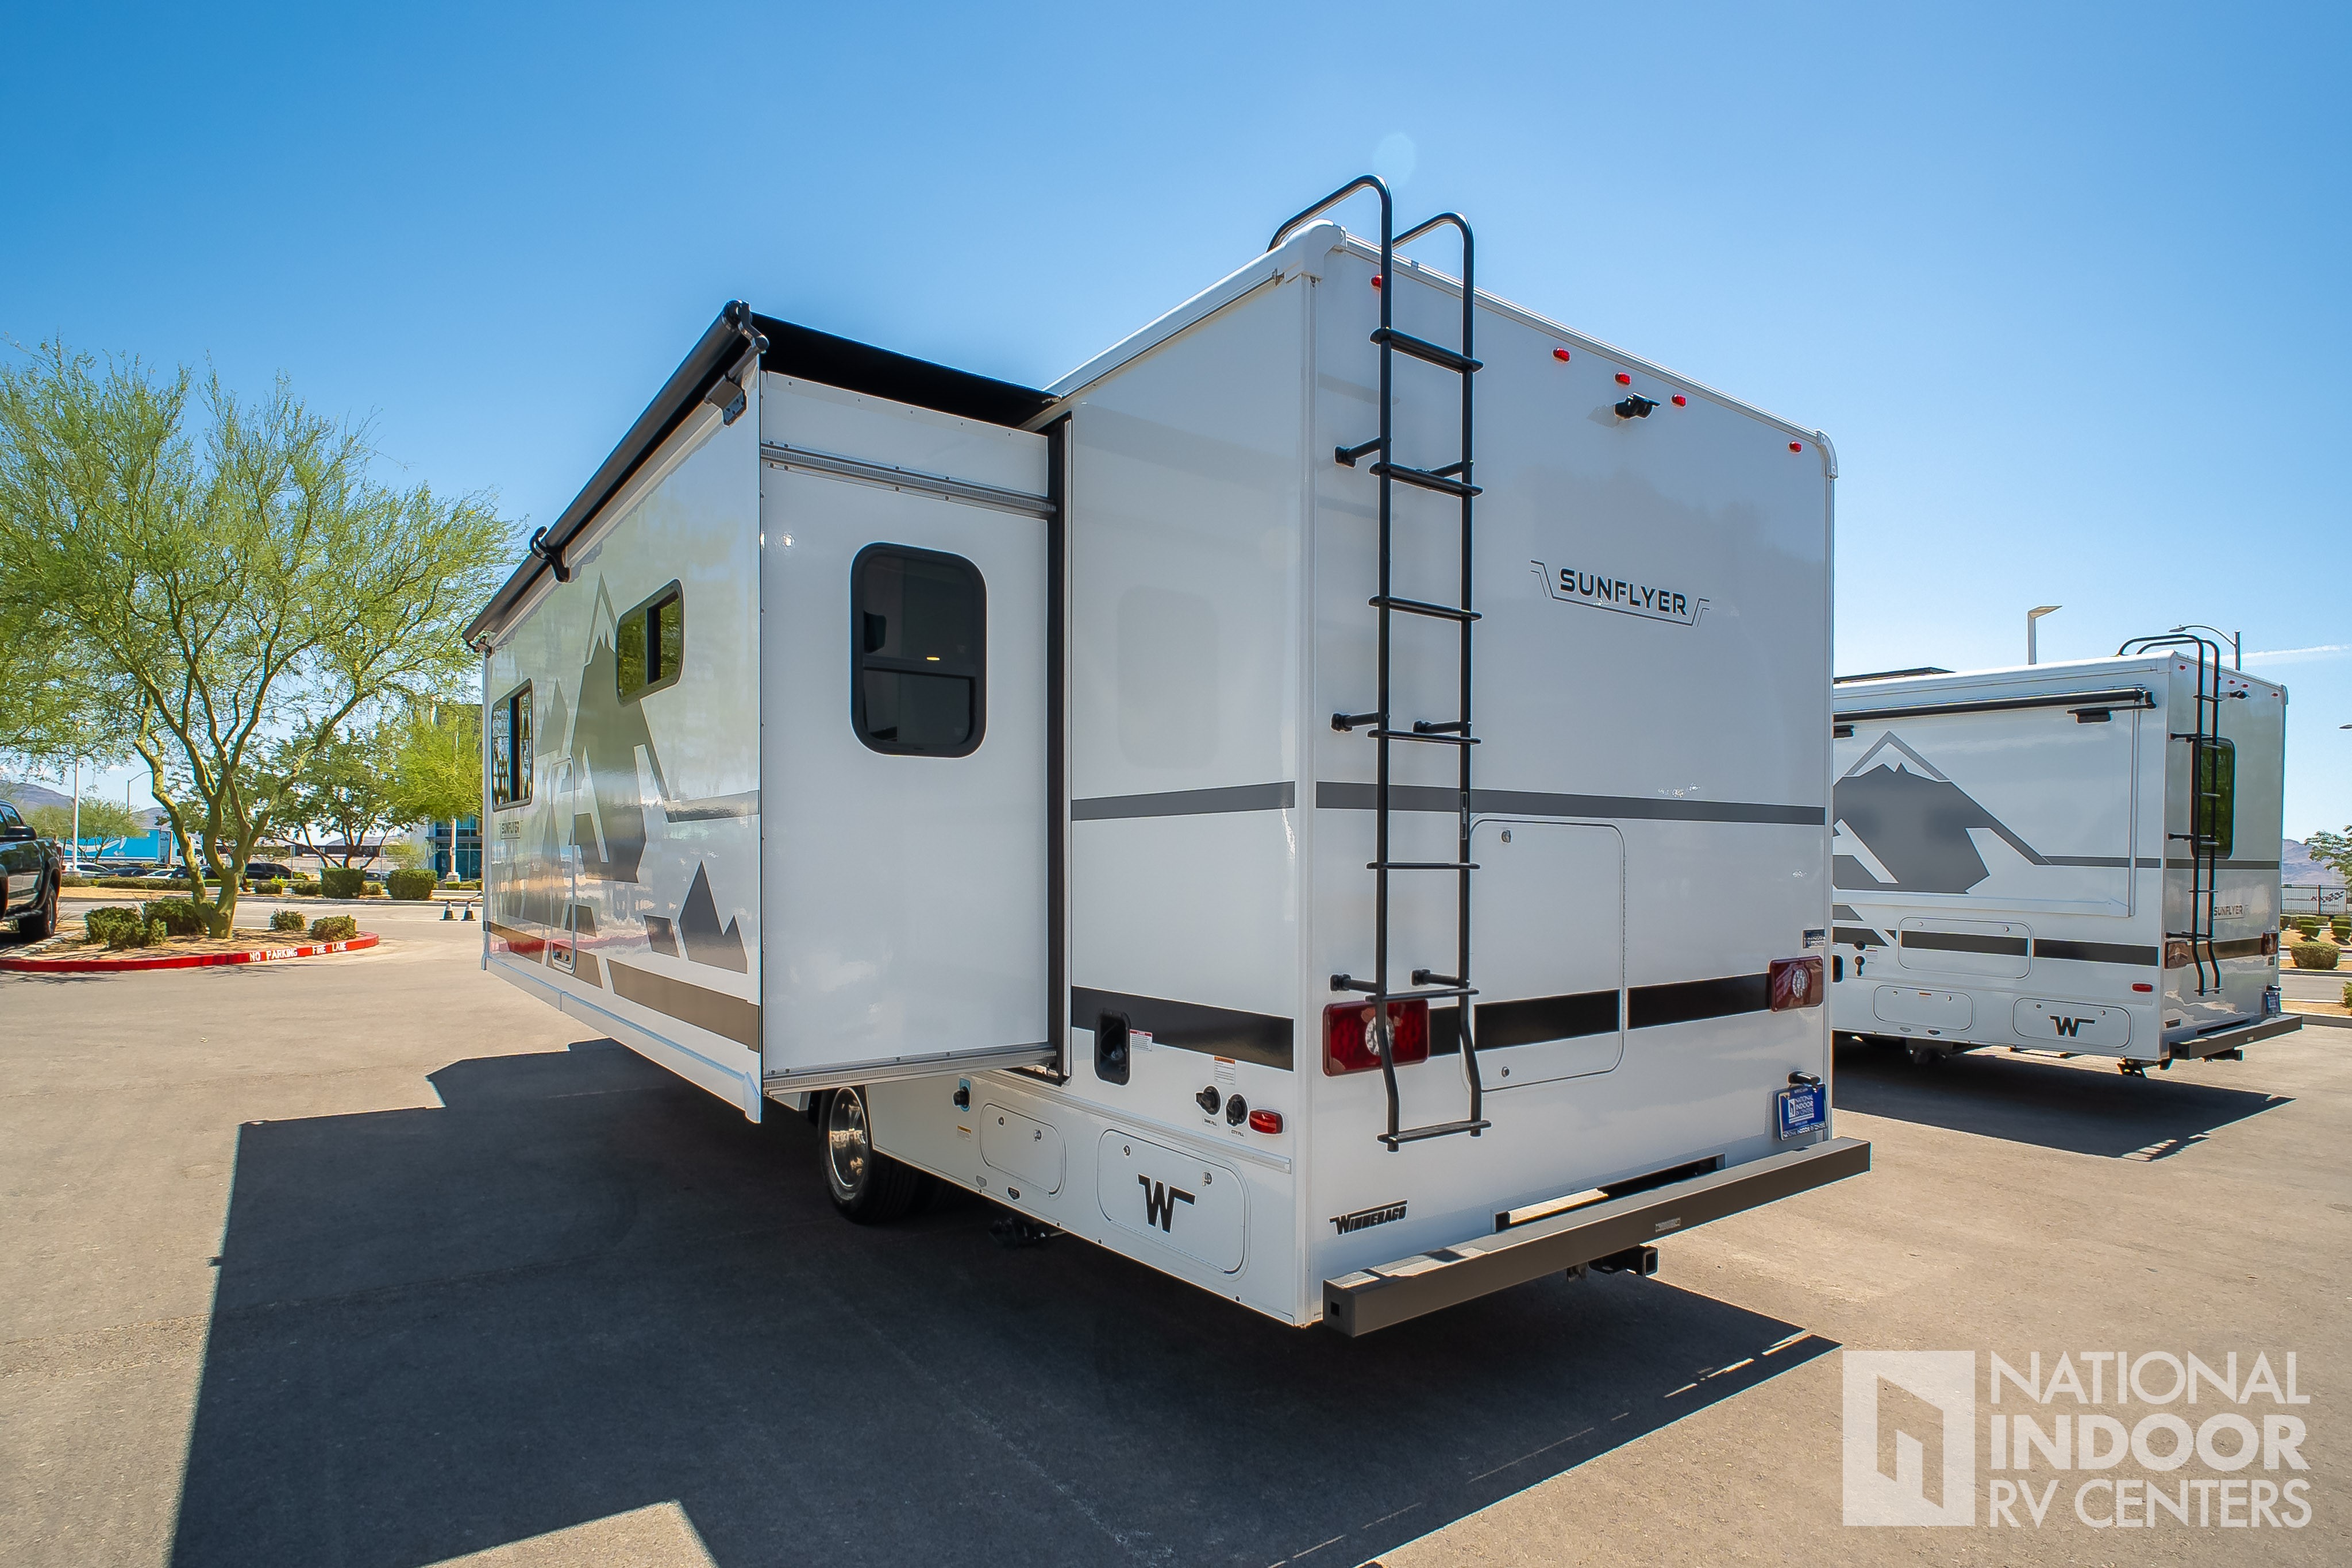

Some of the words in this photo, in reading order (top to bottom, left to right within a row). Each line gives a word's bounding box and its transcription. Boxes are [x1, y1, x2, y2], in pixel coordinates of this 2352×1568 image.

[1560, 568, 1687, 616] SUNFLYER
[2214, 905, 2243, 916] SUNFLYER
[249, 951, 261, 961] NO
[265, 947, 298, 960] PARKING
[312, 944, 326, 954] FIRE
[332, 942, 347, 951] LANE
[1329, 1200, 1408, 1235] WINNEBAGO
